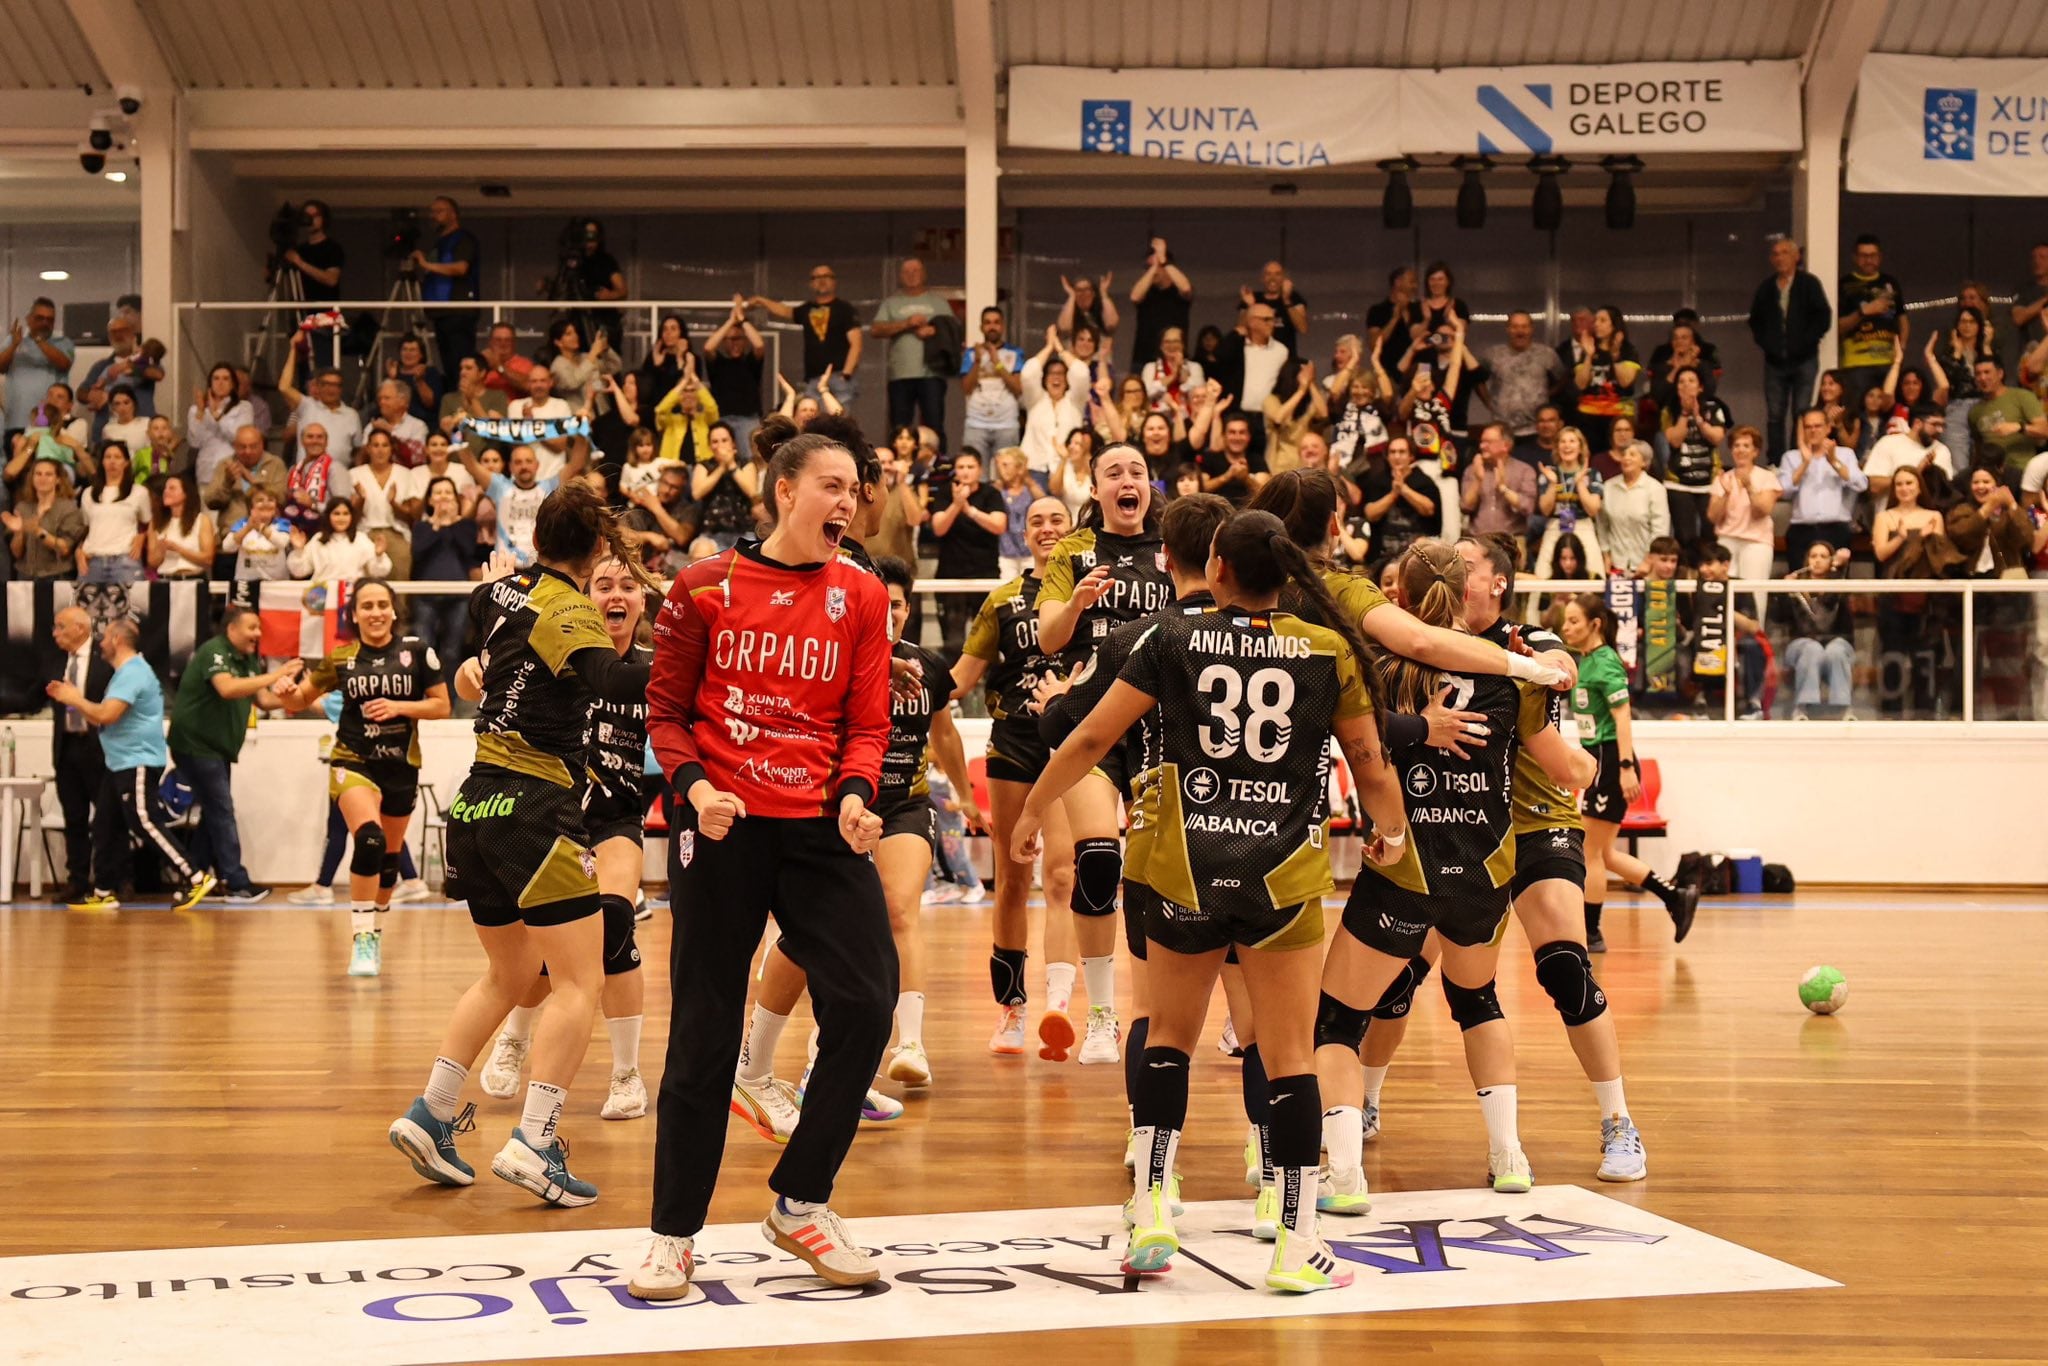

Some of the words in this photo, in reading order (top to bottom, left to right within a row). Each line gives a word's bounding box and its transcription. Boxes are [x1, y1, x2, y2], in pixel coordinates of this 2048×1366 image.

[1570, 79, 1722, 105] DEPORTE
[1146, 106, 1259, 132] XUNTA
[1570, 110, 1707, 136] GALEGO
[1143, 140, 1184, 160] DE
[1195, 140, 1330, 166] GALICIA
[1988, 131, 2031, 156] DE
[1007, 594, 1026, 615] 15
[1084, 579, 1169, 611] RPAGU
[715, 629, 839, 682] ORPAGU
[1188, 629, 1233, 655] ANIA
[1240, 634, 1312, 660] RAMOS
[347, 673, 412, 699] ORPAGU
[745, 705, 761, 716] DE
[747, 693, 792, 709] XUNTA
[1197, 664, 1296, 763] 38
[771, 766, 807, 776] MONTE
[782, 775, 813, 784] TECLA
[1442, 771, 1490, 793] TESOL
[1227, 778, 1292, 805] TESOL
[1211, 877, 1241, 888] ZICO
[1441, 865, 1464, 874] ZICO
[1152, 1129, 1171, 1168] GUARDÉS
[1284, 1169, 1301, 1208] GUARDÉS
[1283, 1211, 1297, 1228] ATL
[10, 1263, 526, 1300] Consulto
